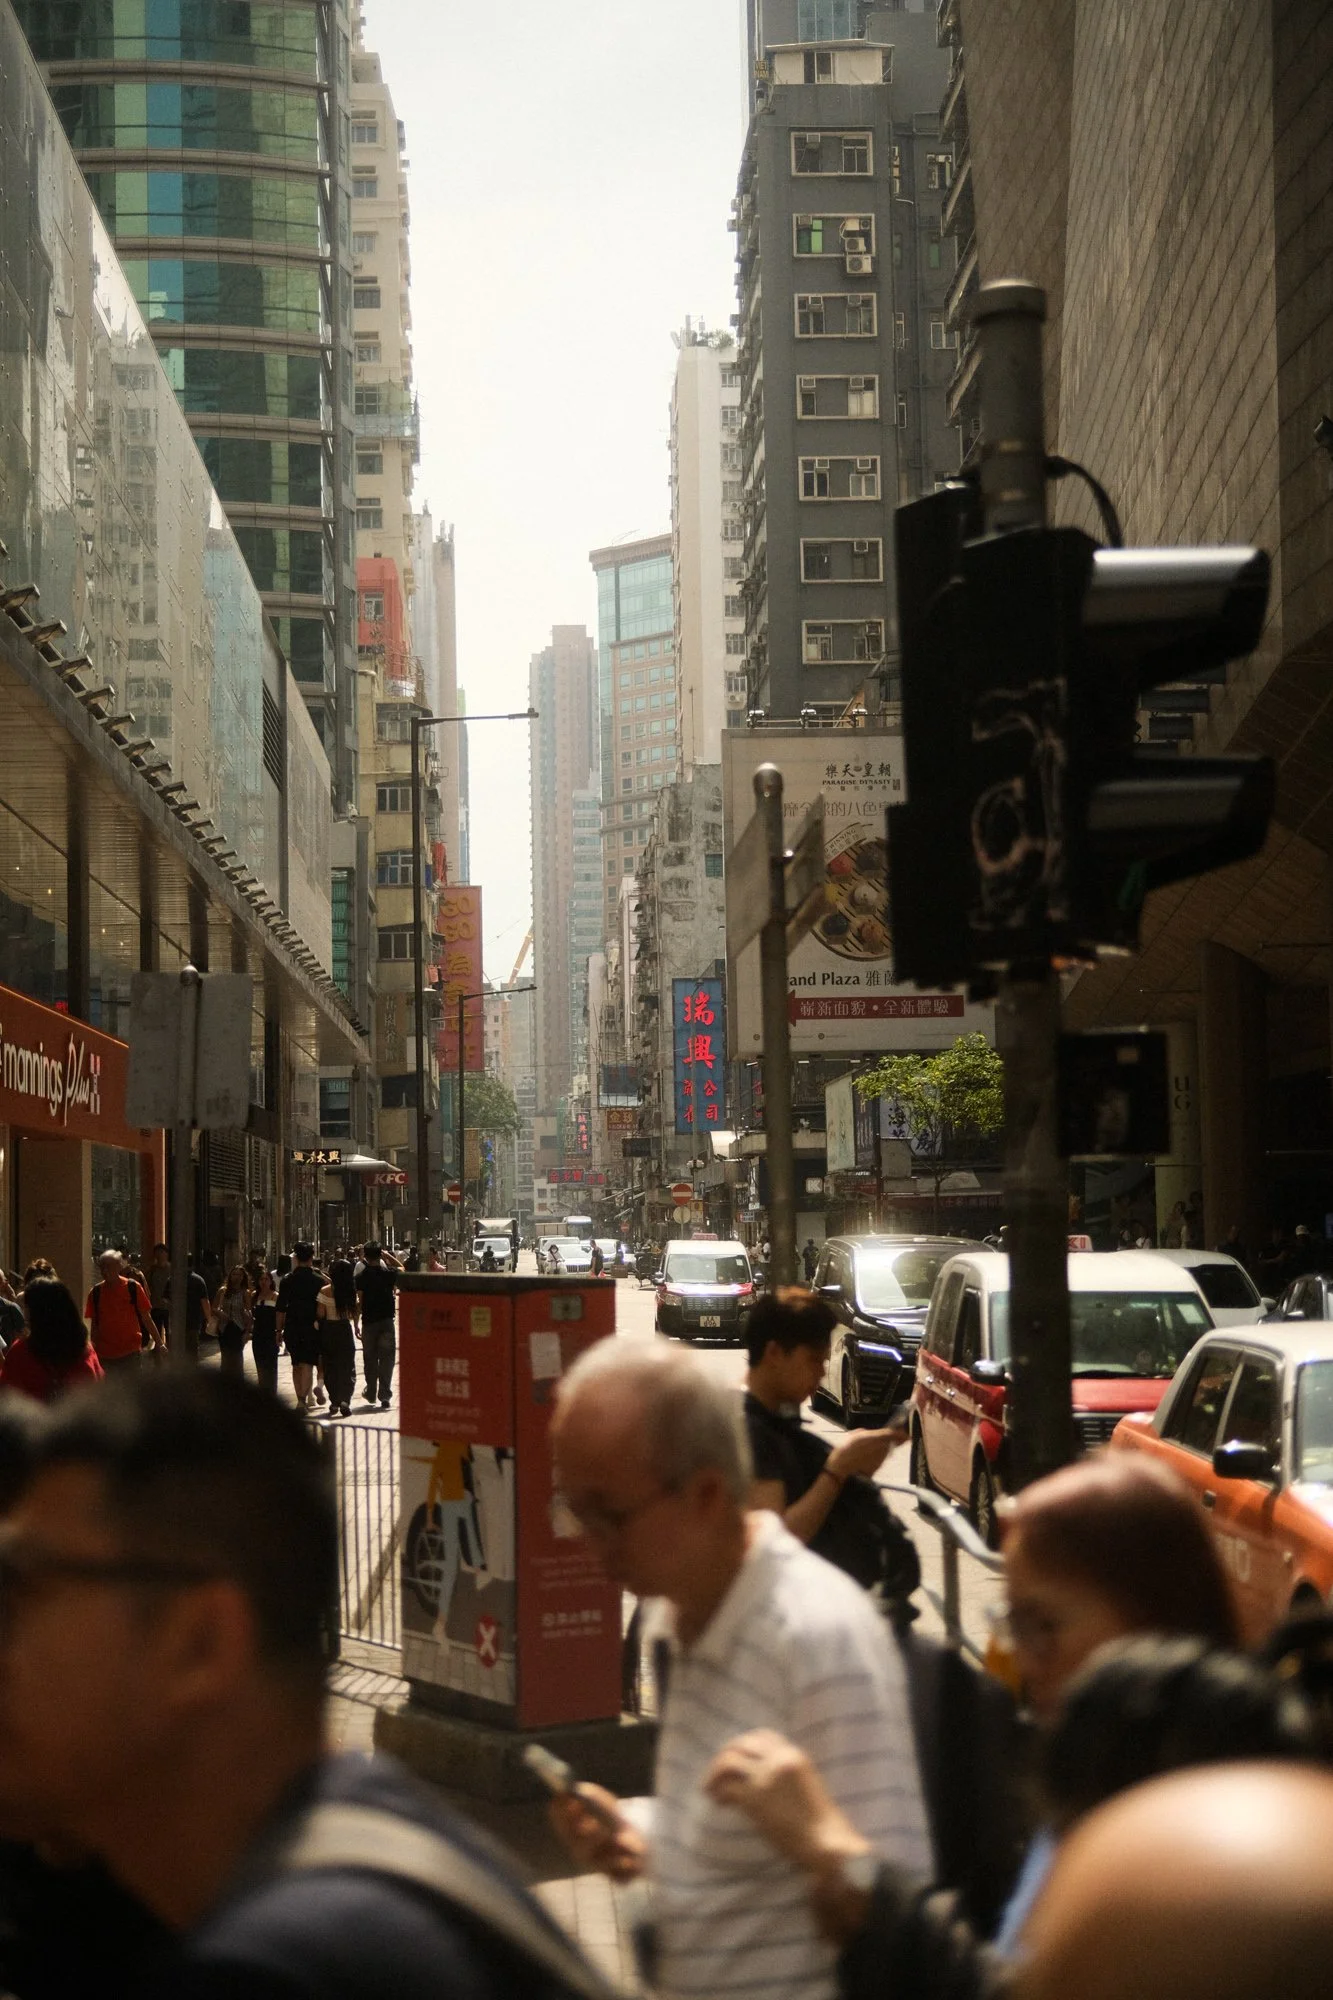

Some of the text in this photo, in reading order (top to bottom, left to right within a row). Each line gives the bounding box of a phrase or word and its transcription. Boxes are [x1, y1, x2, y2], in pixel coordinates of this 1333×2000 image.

[787, 972, 860, 986] and Plaza
[3, 1041, 63, 1117] mannings
[374, 1172, 406, 1185] KFC
